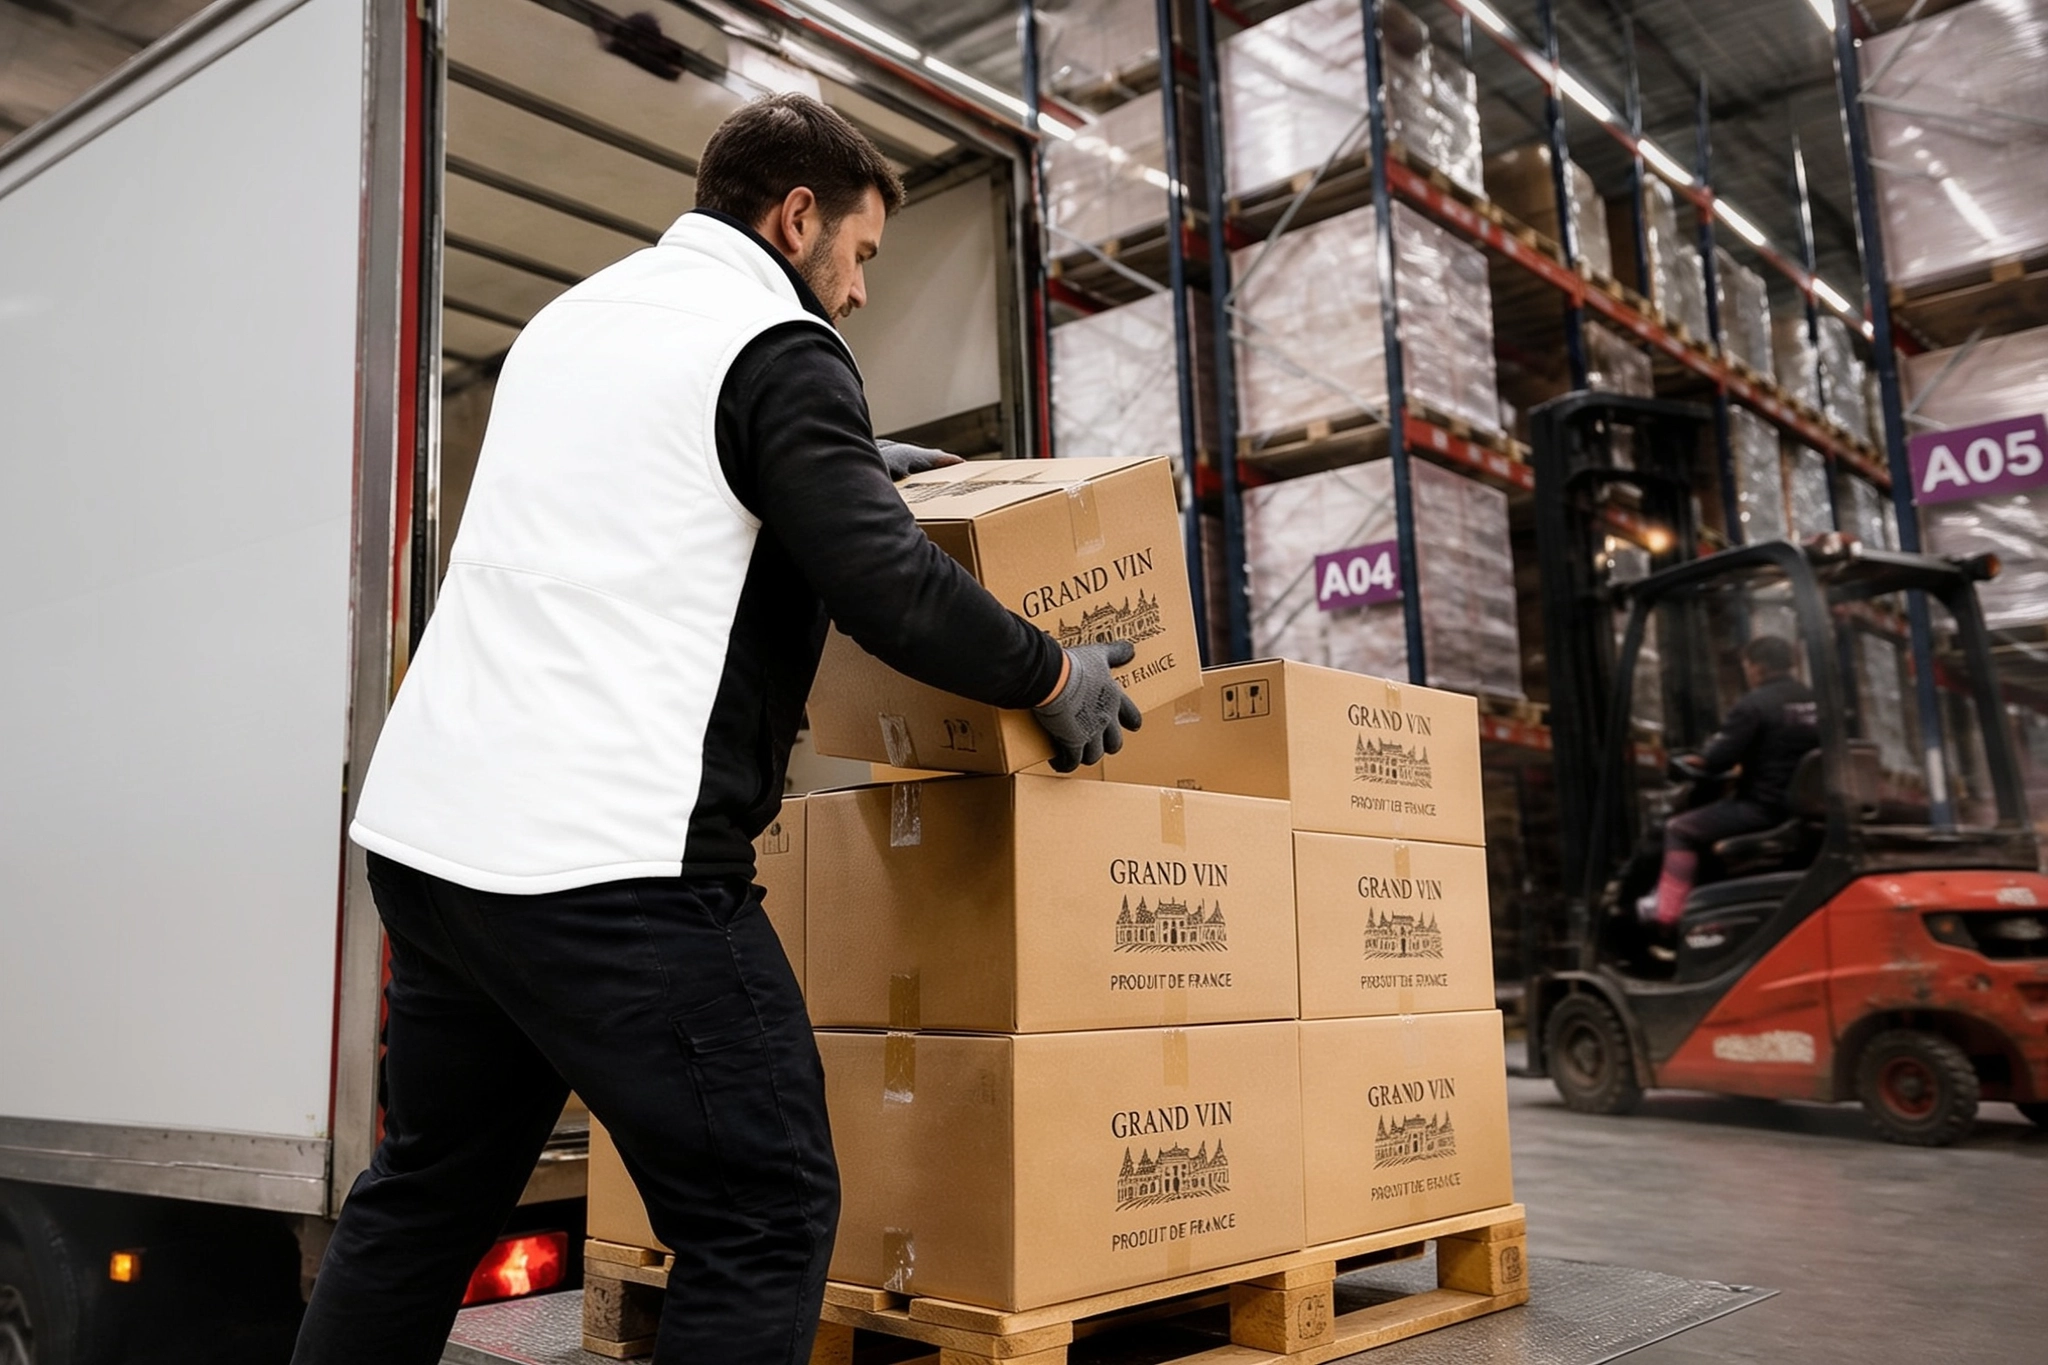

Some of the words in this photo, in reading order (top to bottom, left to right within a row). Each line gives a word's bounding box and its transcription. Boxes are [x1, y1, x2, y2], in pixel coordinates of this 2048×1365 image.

[1922, 428, 2044, 493] A05
[1022, 566, 1109, 618] GRAND
[1113, 547, 1153, 582] VIN
[1319, 551, 1397, 602] A04
[1348, 703, 1402, 732] GRAND
[1406, 712, 1432, 736] VIN
[1110, 858, 1187, 886] GRAND
[1192, 863, 1228, 887] VIN
[1358, 876, 1412, 899] GRAND
[1415, 879, 1442, 900] VIN
[1110, 974, 1167, 991] PRODUIT
[1168, 973, 1185, 989] DE
[1188, 973, 1232, 989] FRANCE
[1367, 1081, 1424, 1107] GRAND
[1427, 1078, 1455, 1100] VIN
[1111, 1105, 1189, 1139] GRAND
[1195, 1101, 1232, 1127] VIN
[1112, 1226, 1168, 1252] PRODUIT
[1169, 1222, 1187, 1240] DE
